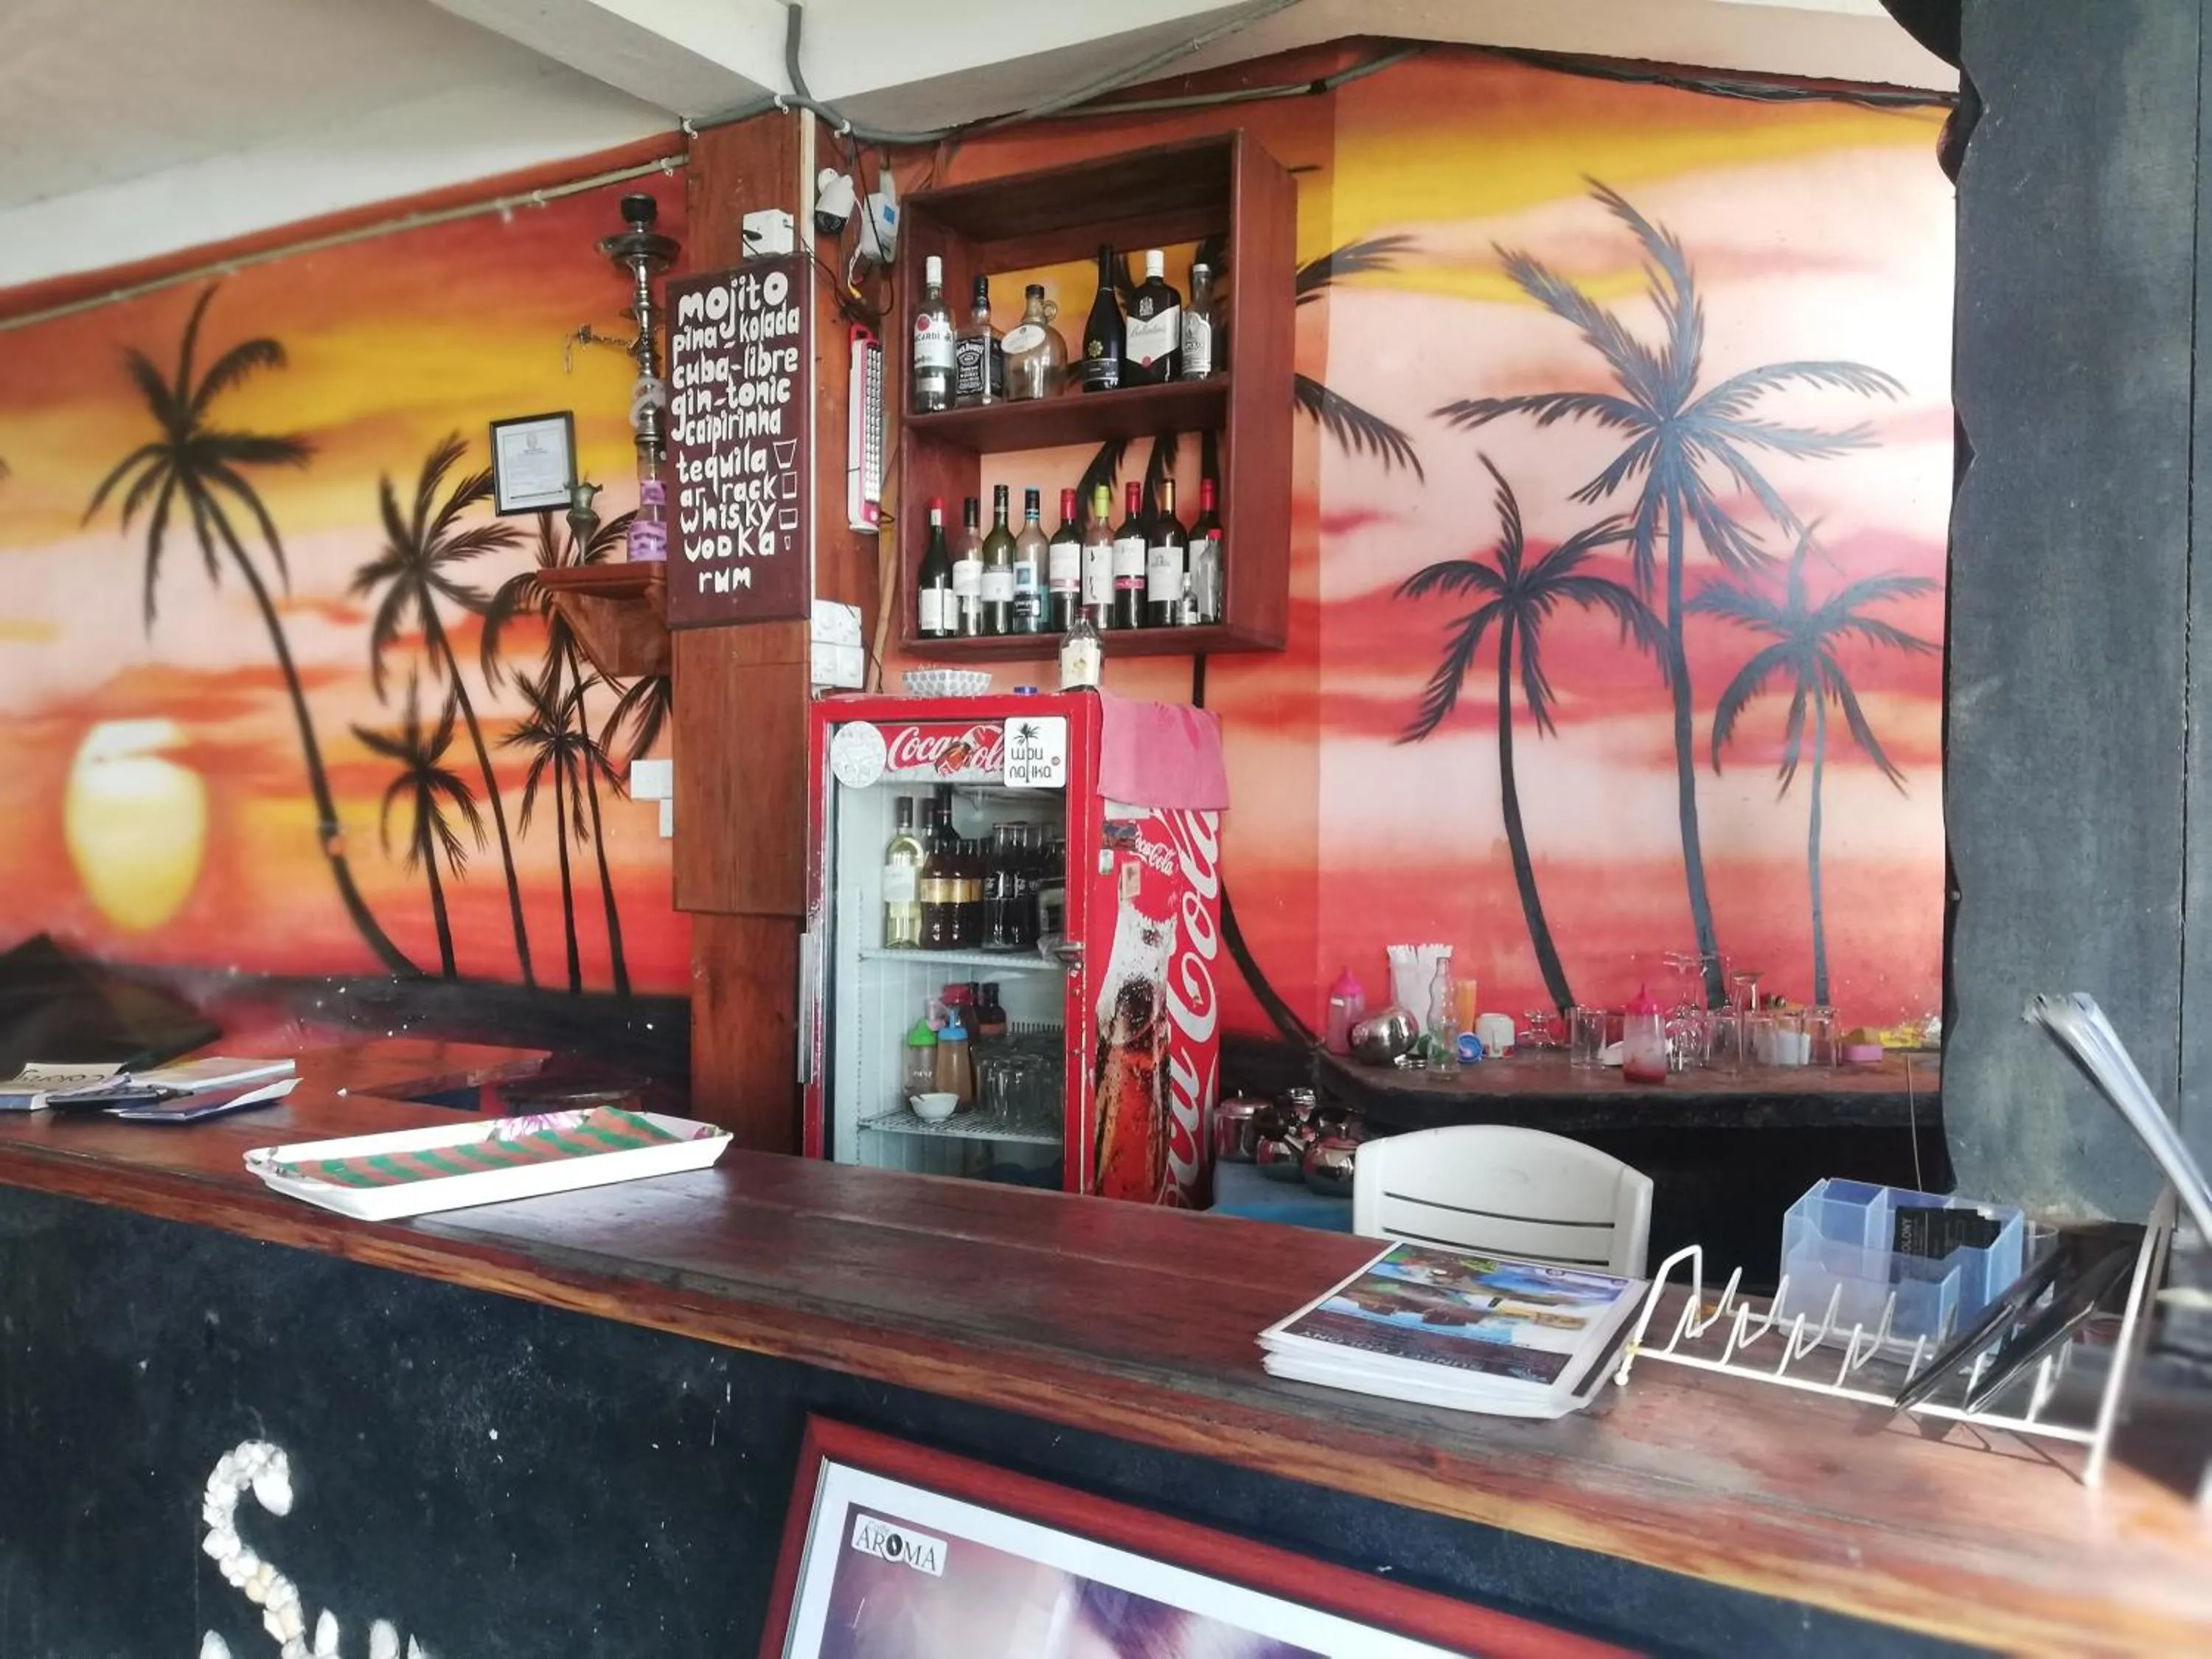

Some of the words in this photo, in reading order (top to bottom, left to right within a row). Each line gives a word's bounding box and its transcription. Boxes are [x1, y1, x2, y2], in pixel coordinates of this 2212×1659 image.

[678, 271, 788, 339] mojito
[686, 404, 781, 457] caipirinha
[676, 433, 767, 497] tequila
[681, 496, 776, 540] whisky
[699, 566, 751, 594] rum
[855, 1526, 936, 1571] AROMA
